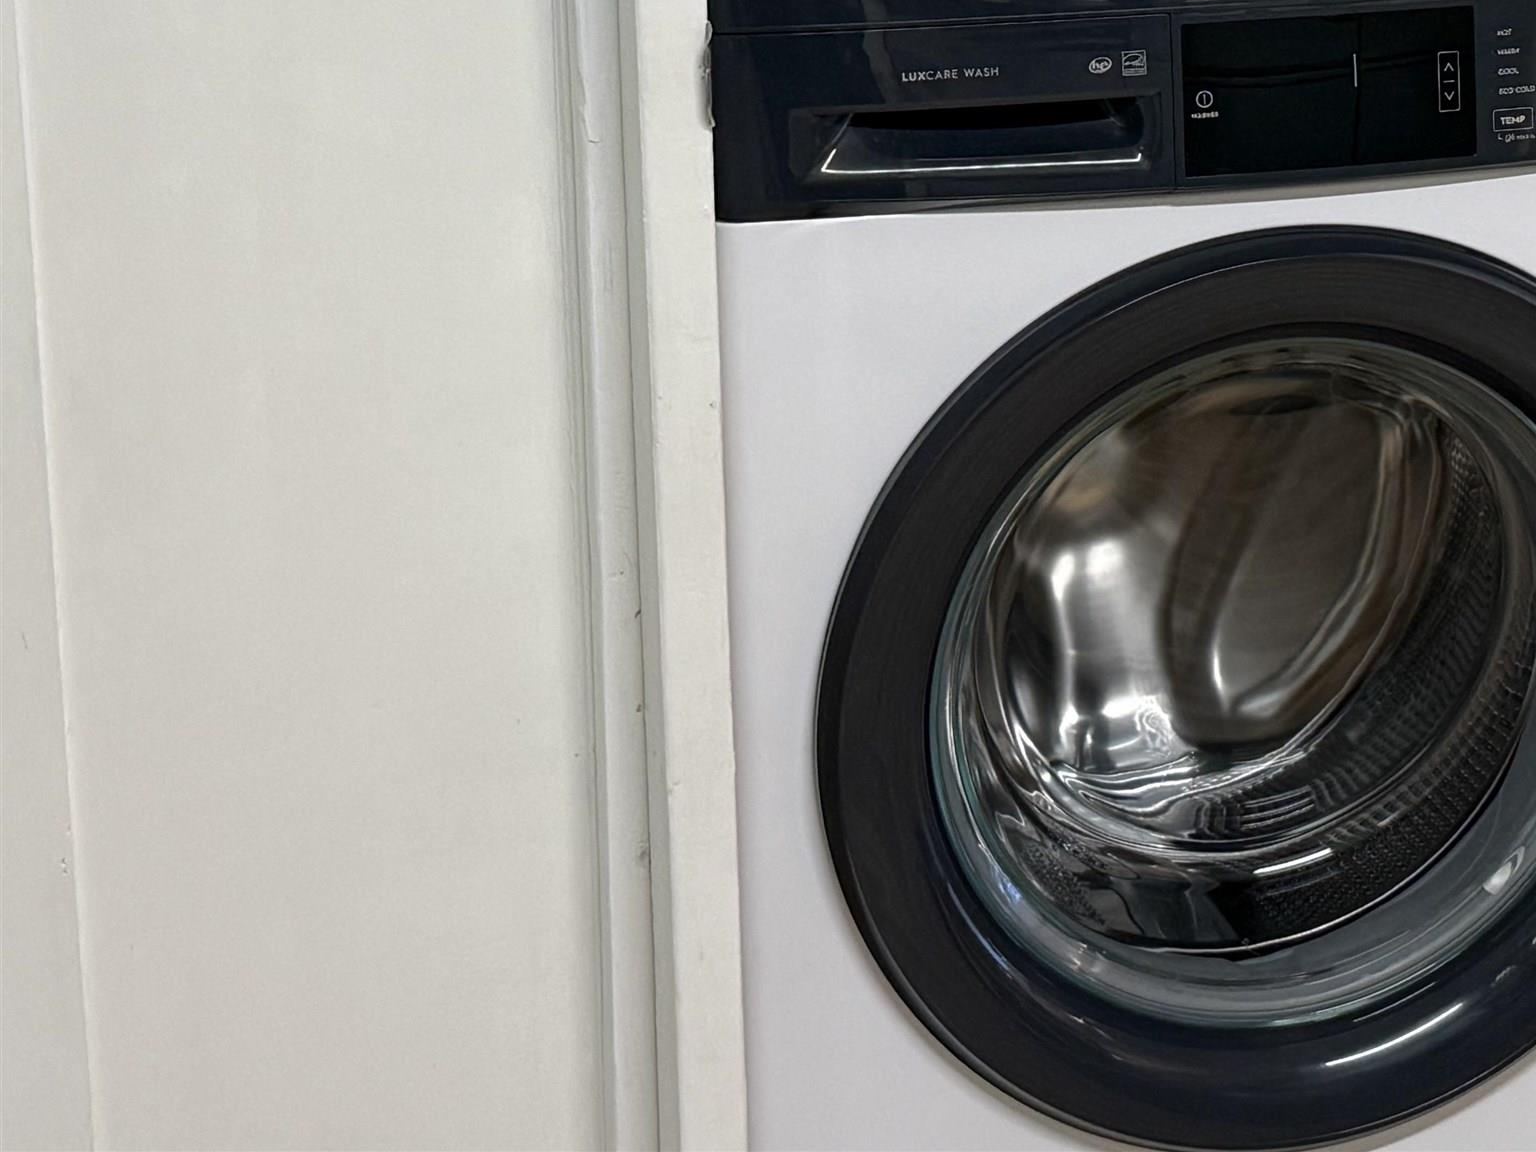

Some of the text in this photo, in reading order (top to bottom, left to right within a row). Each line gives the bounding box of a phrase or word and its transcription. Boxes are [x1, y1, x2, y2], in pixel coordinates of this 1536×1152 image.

[901, 67, 999, 82] LUXCARE WASH
[1497, 67, 1519, 76] COOL
[1498, 85, 1536, 95] ECO COLD
[1500, 115, 1526, 125] TEMP
